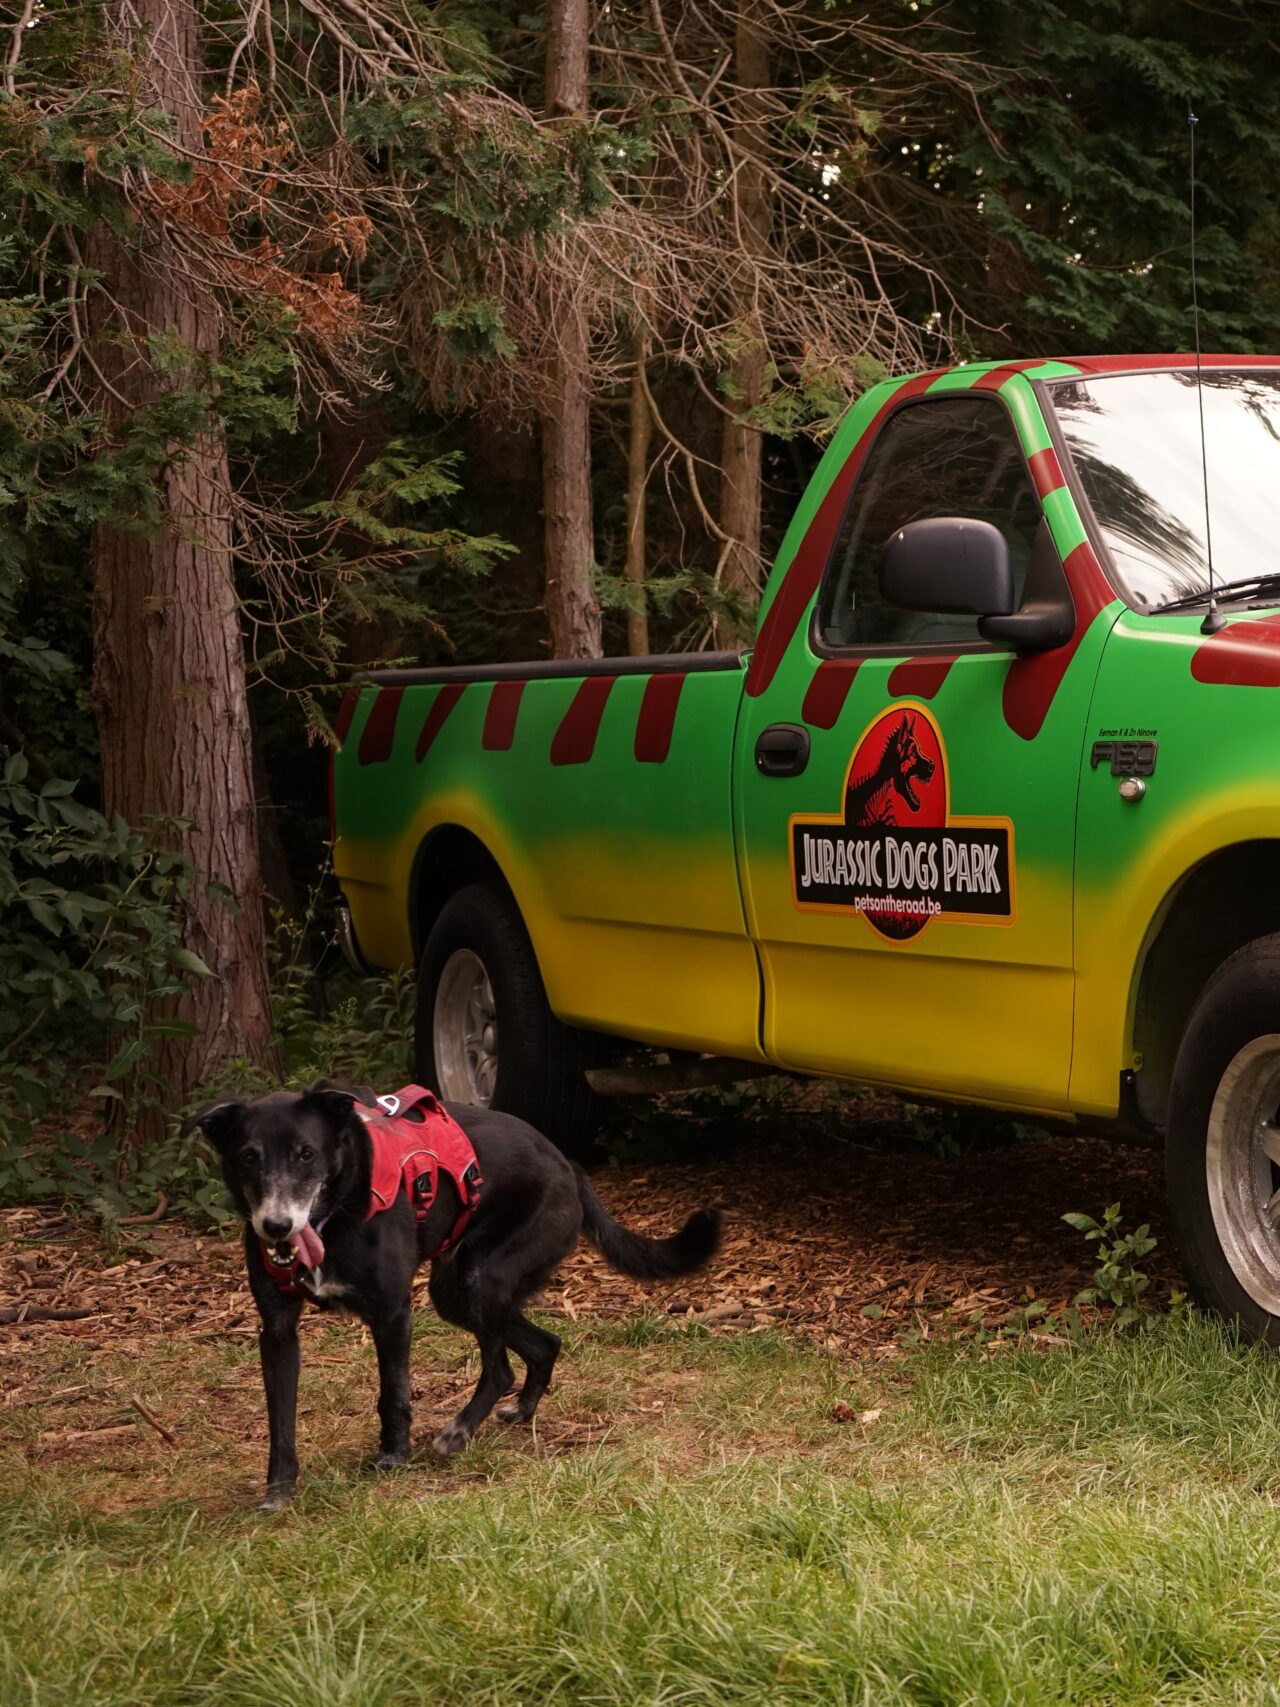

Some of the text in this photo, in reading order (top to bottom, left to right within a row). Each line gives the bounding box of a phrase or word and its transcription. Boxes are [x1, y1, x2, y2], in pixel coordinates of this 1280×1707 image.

[801, 833, 1001, 894] JURASSIC DOGS PARK
[854, 893, 942, 916] petsontheroad.be
